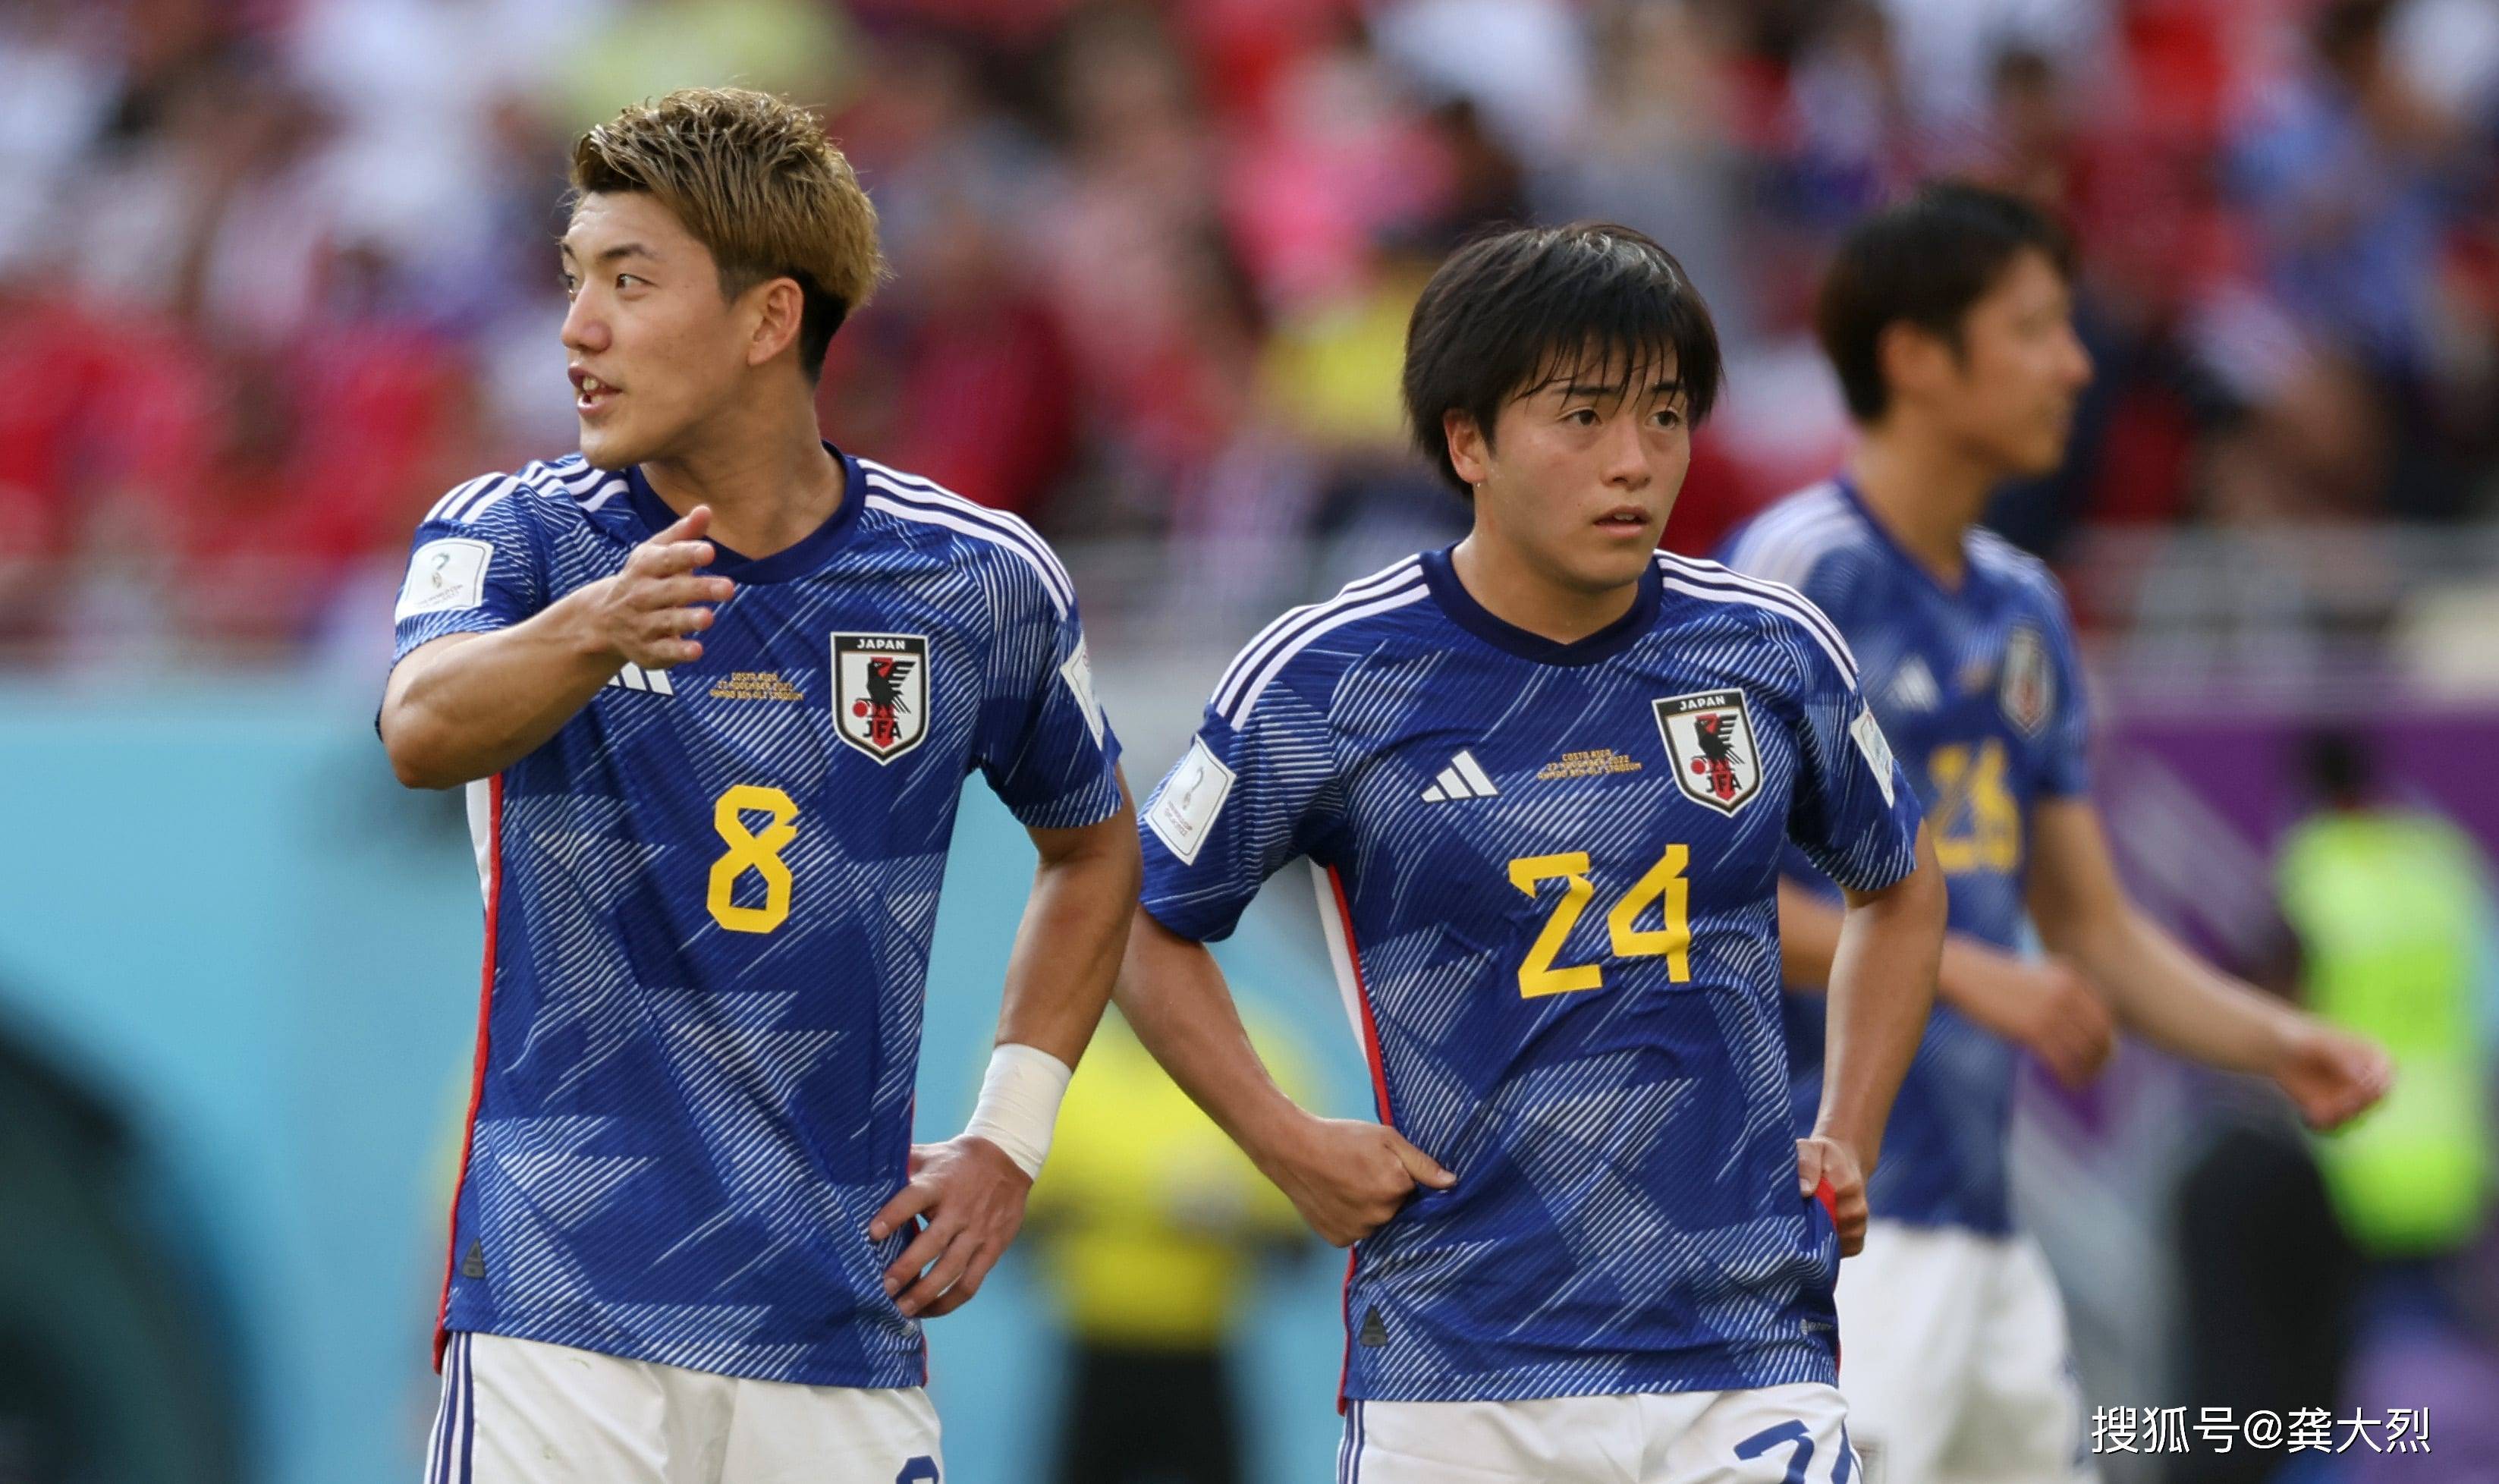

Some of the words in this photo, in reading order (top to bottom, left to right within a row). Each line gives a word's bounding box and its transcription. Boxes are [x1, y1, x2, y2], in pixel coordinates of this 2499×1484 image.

[856, 638, 907, 650] JAPAN
[1679, 695, 1726, 711] JAPAN
[862, 720, 903, 740] JFA
[1706, 773, 1743, 793] JFA
[706, 784, 800, 934] 8
[1507, 843, 1691, 999] 24
